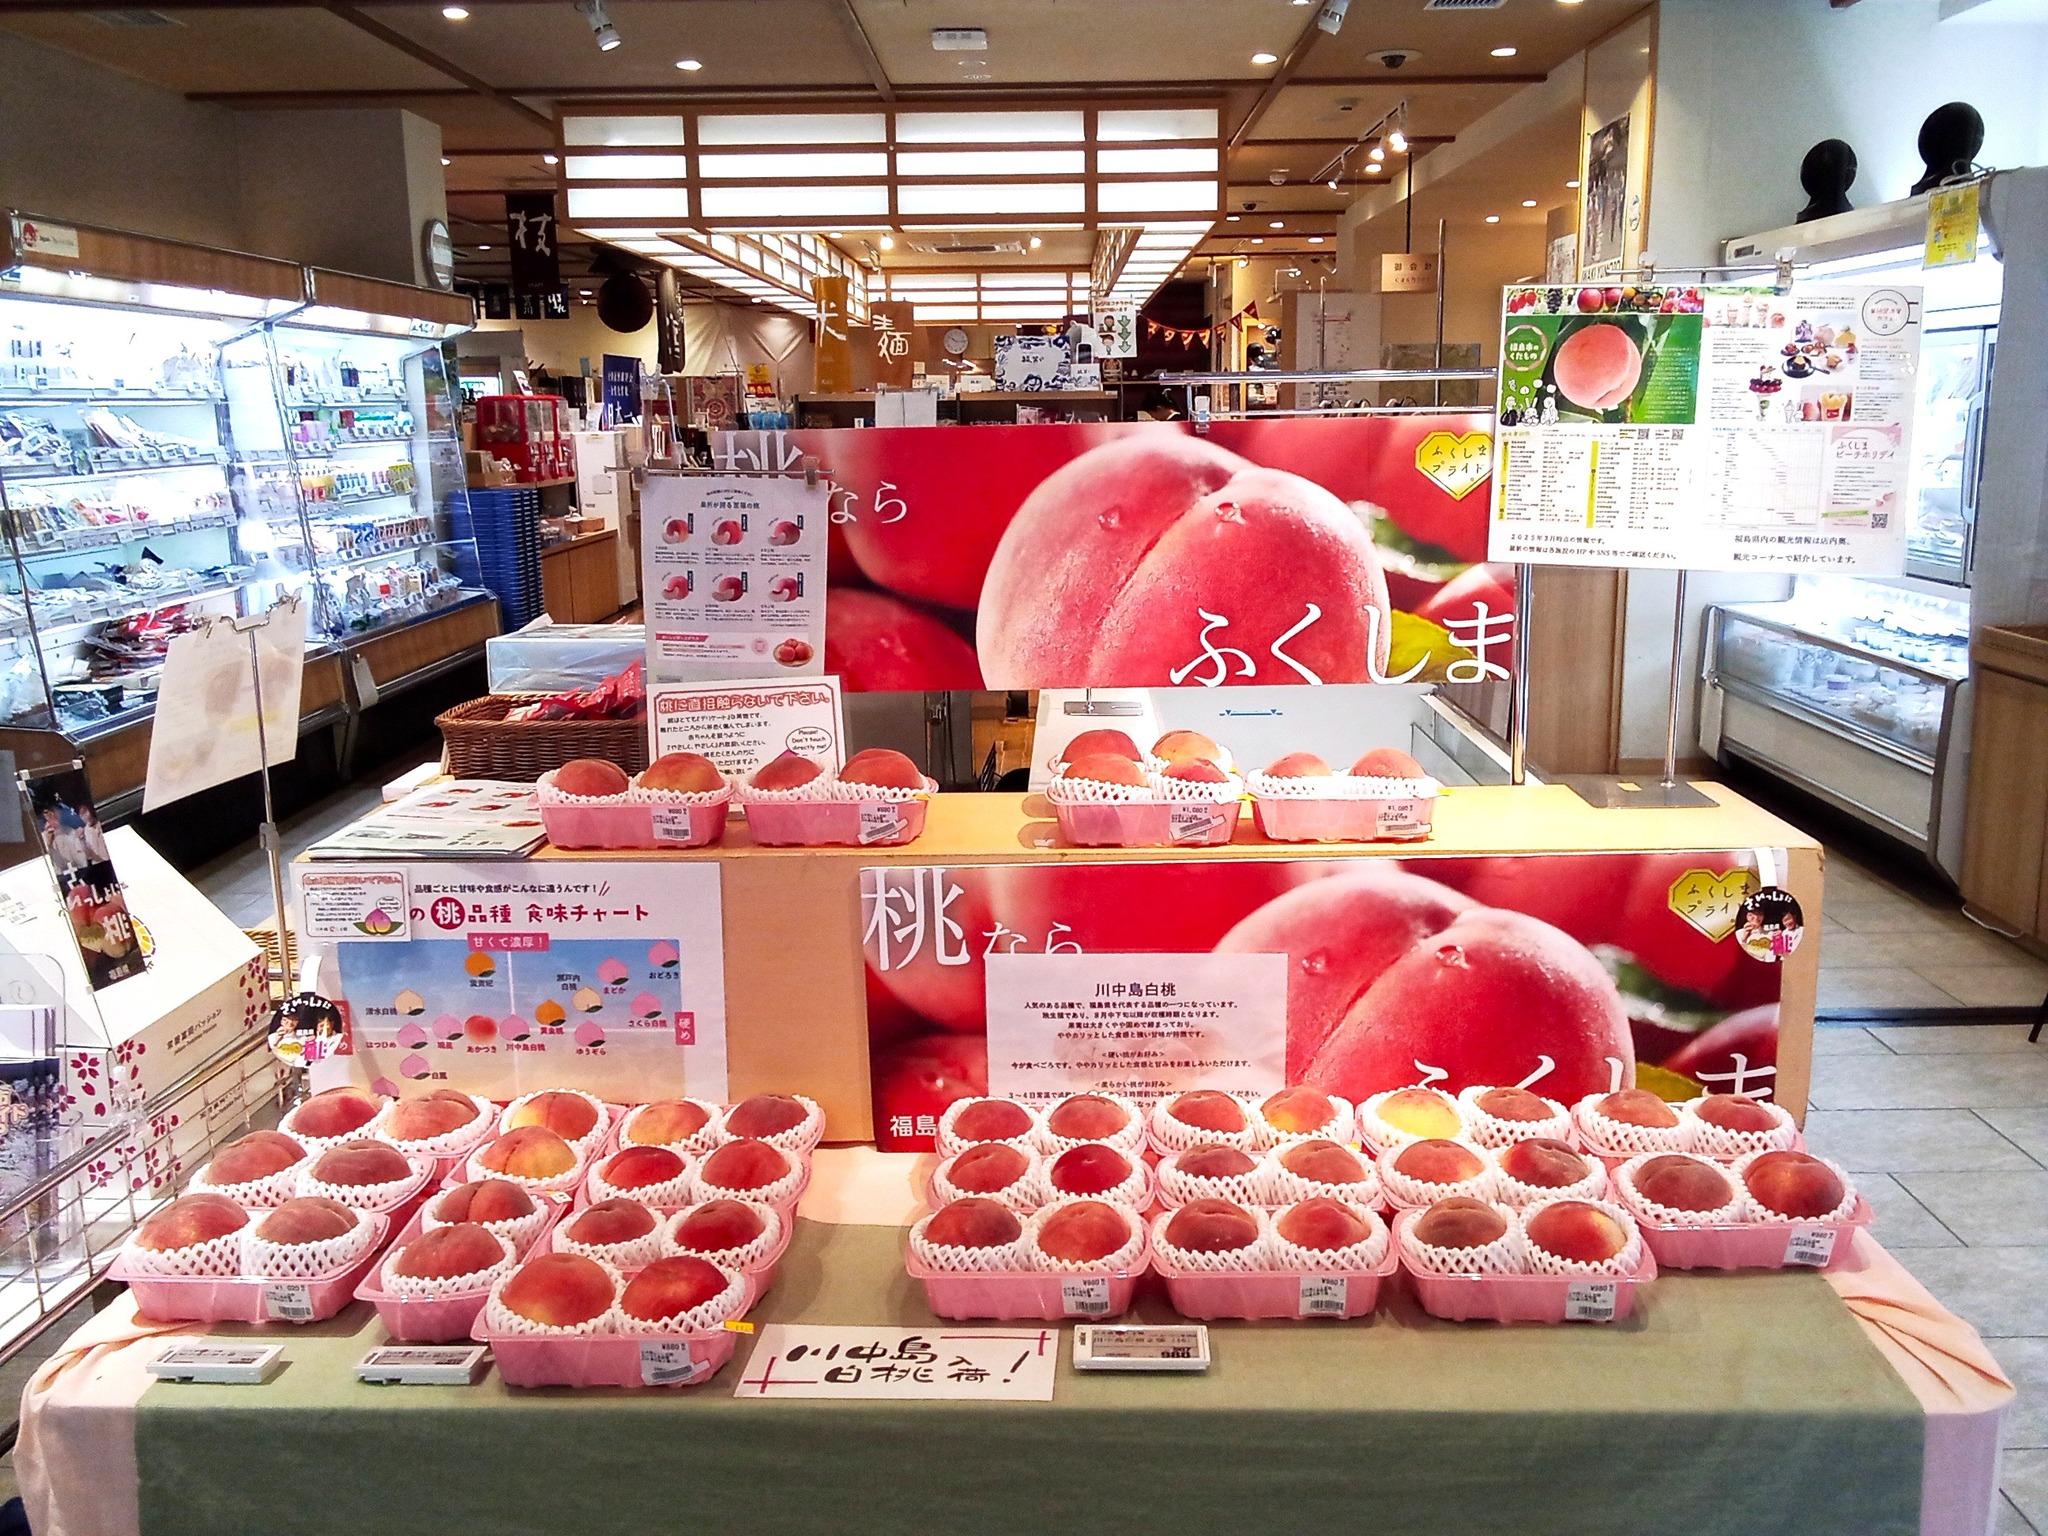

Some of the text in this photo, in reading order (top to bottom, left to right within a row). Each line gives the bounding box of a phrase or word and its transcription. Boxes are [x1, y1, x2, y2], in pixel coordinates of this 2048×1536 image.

[1395, 263, 1431, 271] 御会計
[1432, 445, 1486, 458] ふくしま
[1733, 552, 1856, 564] 観光コーナーで紹介しています。
[1170, 602, 1515, 687] ふくしま
[414, 883, 597, 894] 品種ごとに甘味や食感がこんなに違うんです！
[1687, 883, 1750, 900] ふくしま
[473, 936, 543, 948] 甘くて濃厚！
[648, 971, 680, 980] おどろき
[603, 986, 627, 995] まどか
[1094, 982, 1177, 998] 川中島白桃
[628, 1020, 668, 1028] さくら白桃
[540, 1026, 564, 1035] 黄金桃
[365, 1041, 397, 1049] はつひめ
[466, 1045, 497, 1054] あかつき
[505, 1043, 546, 1052] 川中島白桃
[575, 1047, 607, 1056] ゆうぞら
[785, 1334, 939, 1363] 川中島
[824, 1365, 933, 1383] 白桃
